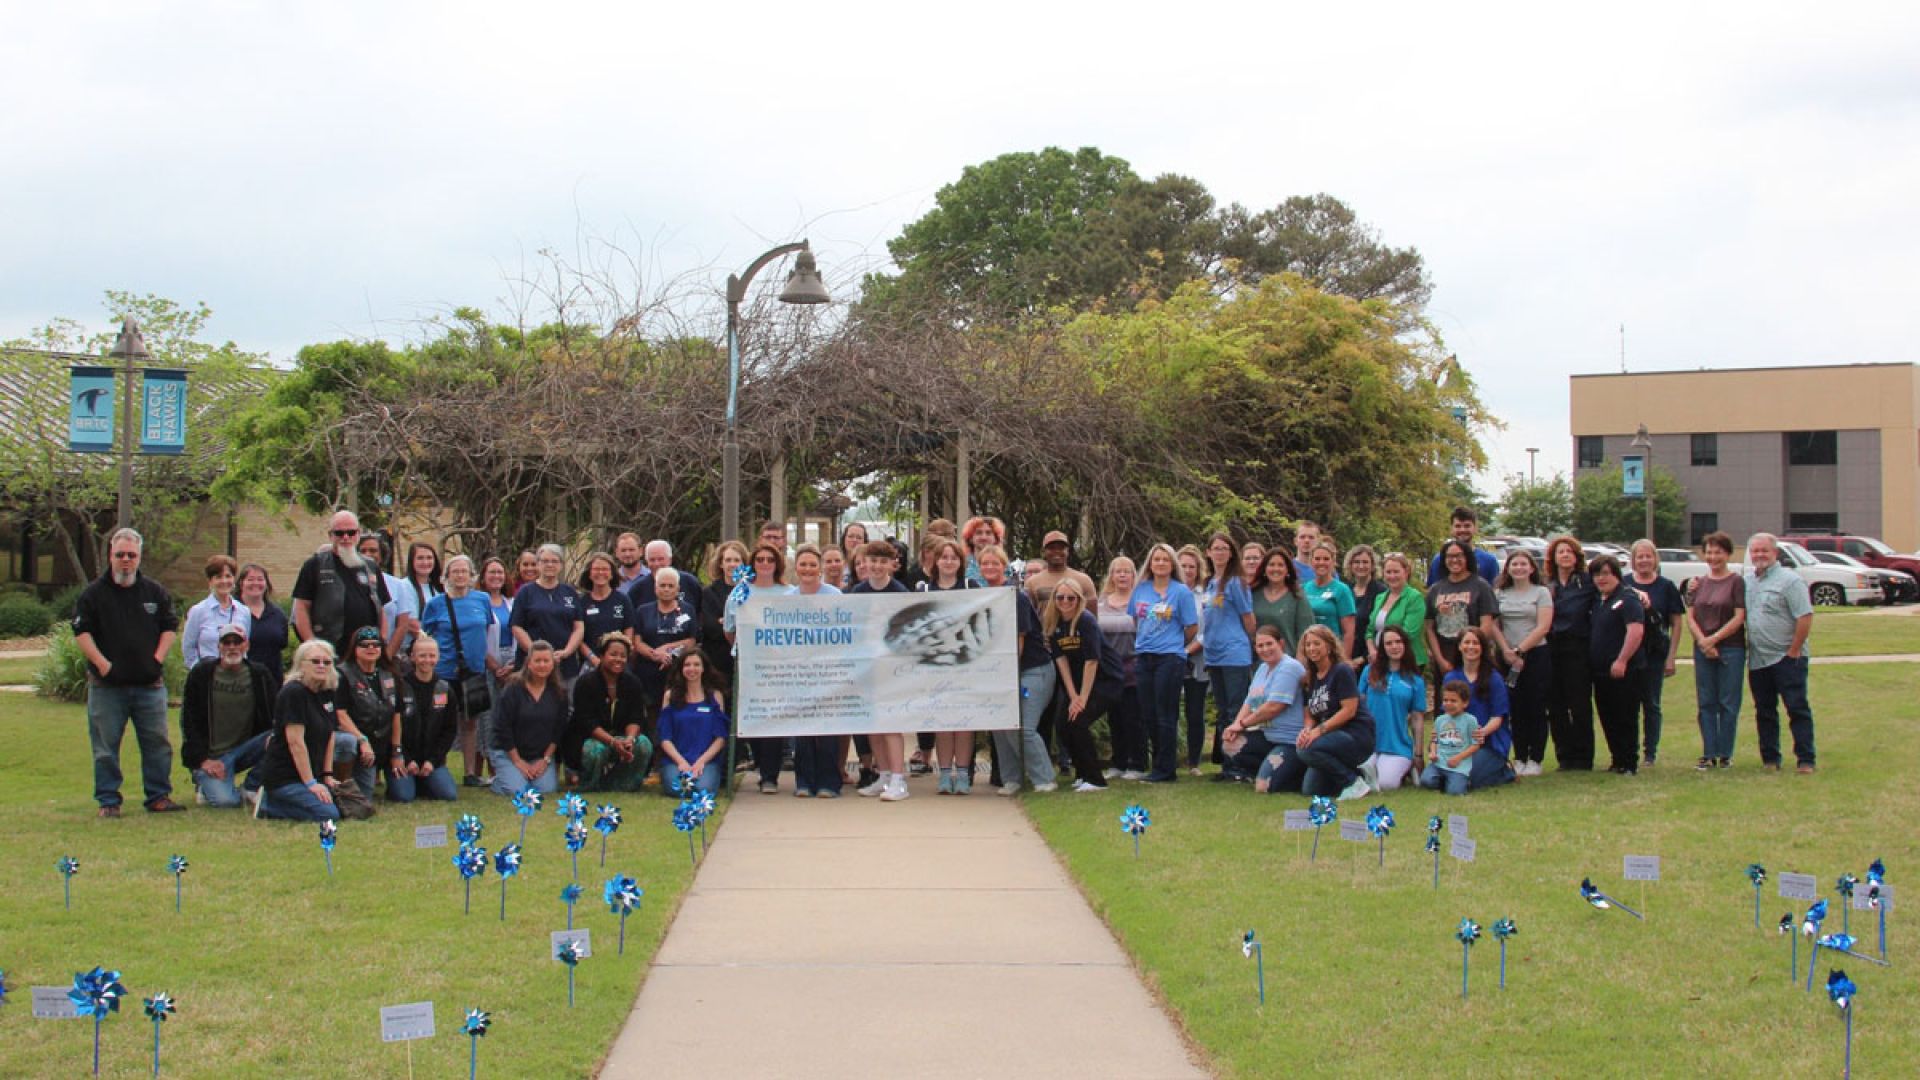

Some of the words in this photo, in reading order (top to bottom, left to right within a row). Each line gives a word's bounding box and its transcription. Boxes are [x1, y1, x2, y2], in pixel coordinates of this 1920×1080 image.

[148, 385, 162, 440] BLACK
[163, 383, 177, 443] HAWKS
[763, 607, 830, 624] Pinwheels
[835, 607, 853, 624] for
[755, 627, 852, 646] PREVENTION
